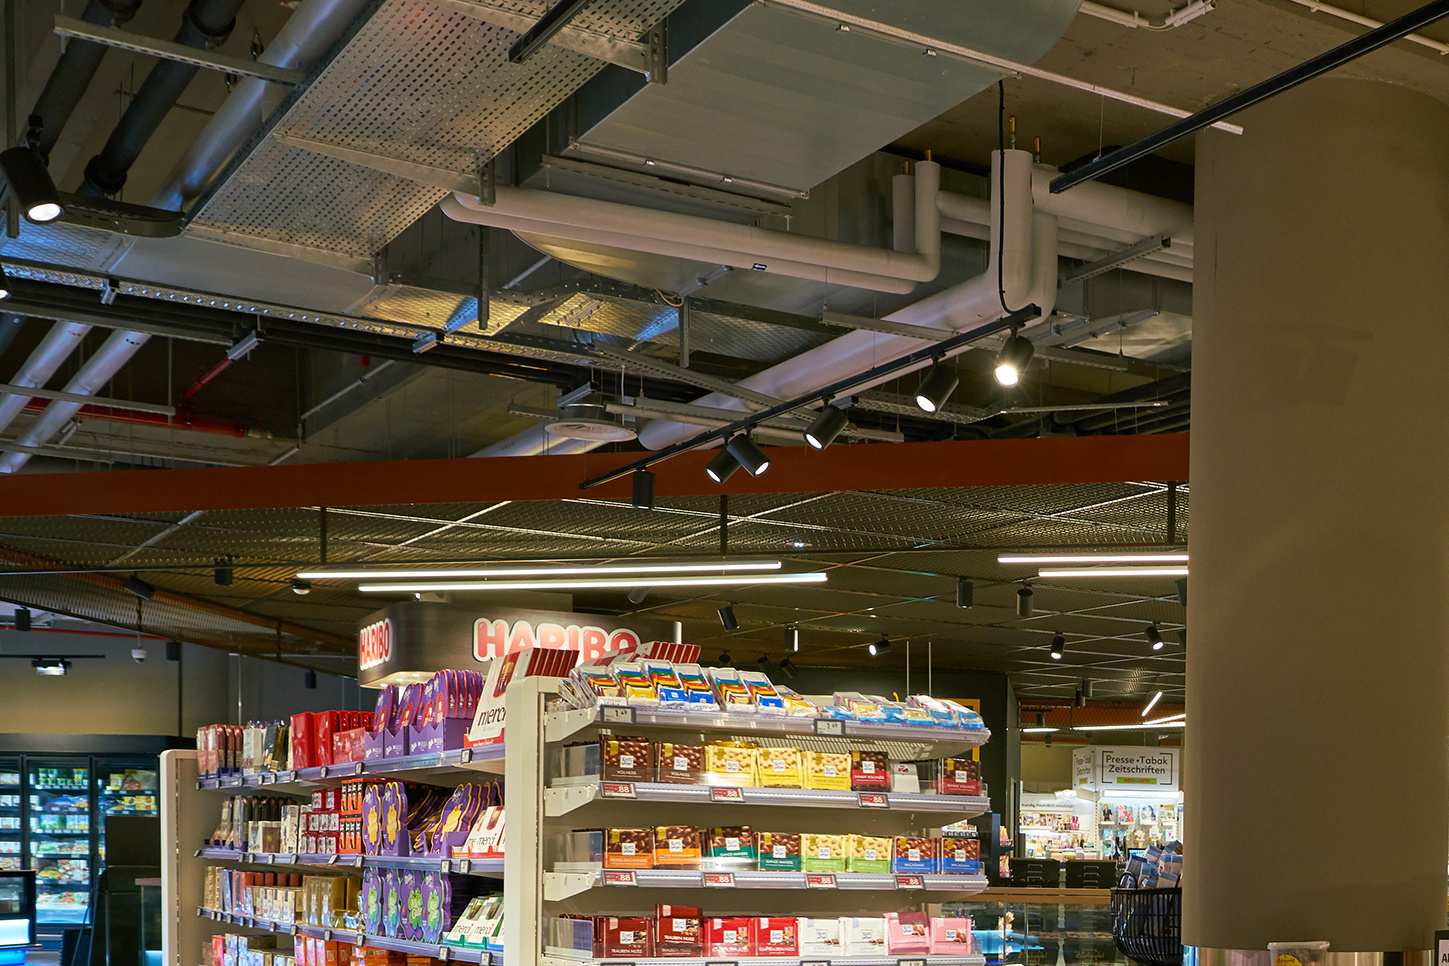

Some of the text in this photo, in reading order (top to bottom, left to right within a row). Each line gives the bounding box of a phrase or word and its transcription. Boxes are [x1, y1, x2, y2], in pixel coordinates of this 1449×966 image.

[360, 618, 391, 670] HARIBO
[1106, 755, 1135, 763] Presse
[1108, 765, 1166, 774] Zeitschriften
